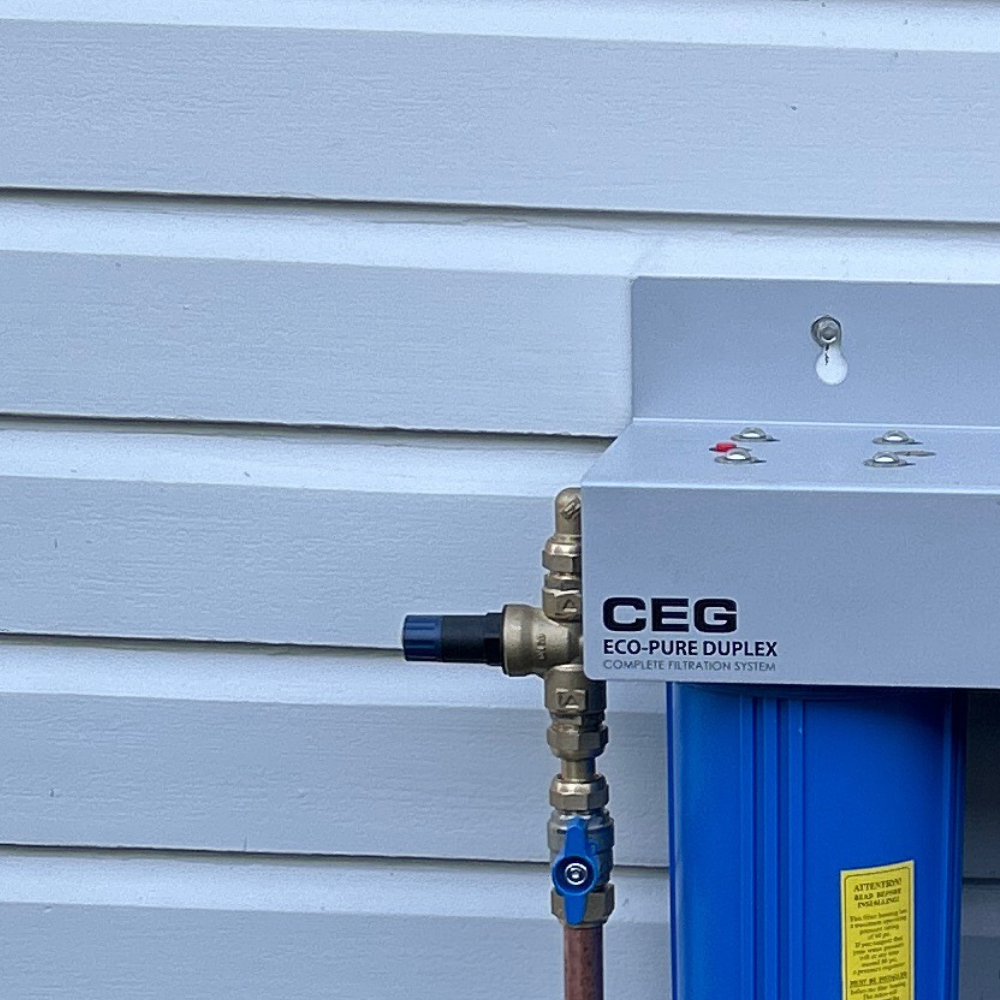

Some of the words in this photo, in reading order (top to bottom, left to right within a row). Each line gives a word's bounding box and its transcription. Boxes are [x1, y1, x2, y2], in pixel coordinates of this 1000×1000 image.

[602, 596, 738, 633] CEG
[603, 638, 698, 656] ECO-PURE
[703, 640, 778, 657] DUPLEX
[603, 659, 665, 671] COMPLETE
[668, 660, 731, 671] FILTRATION
[734, 660, 776, 672] SYSTEM
